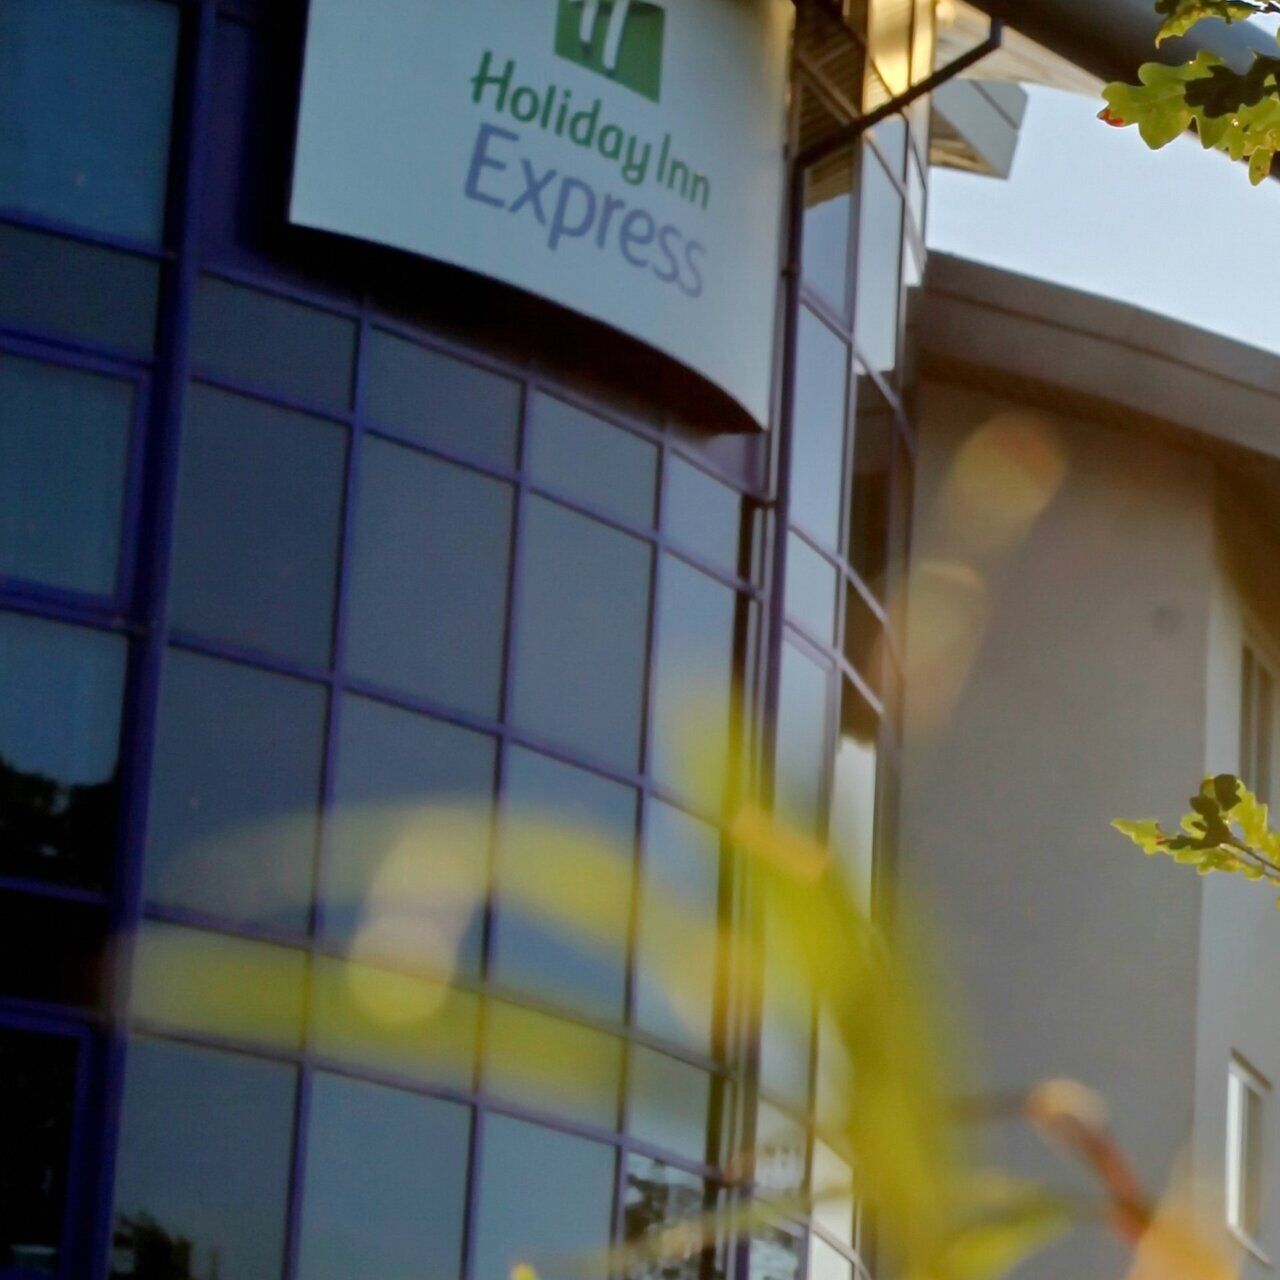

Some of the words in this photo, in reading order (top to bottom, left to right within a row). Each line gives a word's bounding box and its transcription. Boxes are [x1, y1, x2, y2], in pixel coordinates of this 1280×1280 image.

[464, 121, 706, 298] Express
[470, 50, 651, 186] Holiday
[655, 133, 711, 210] Inn
